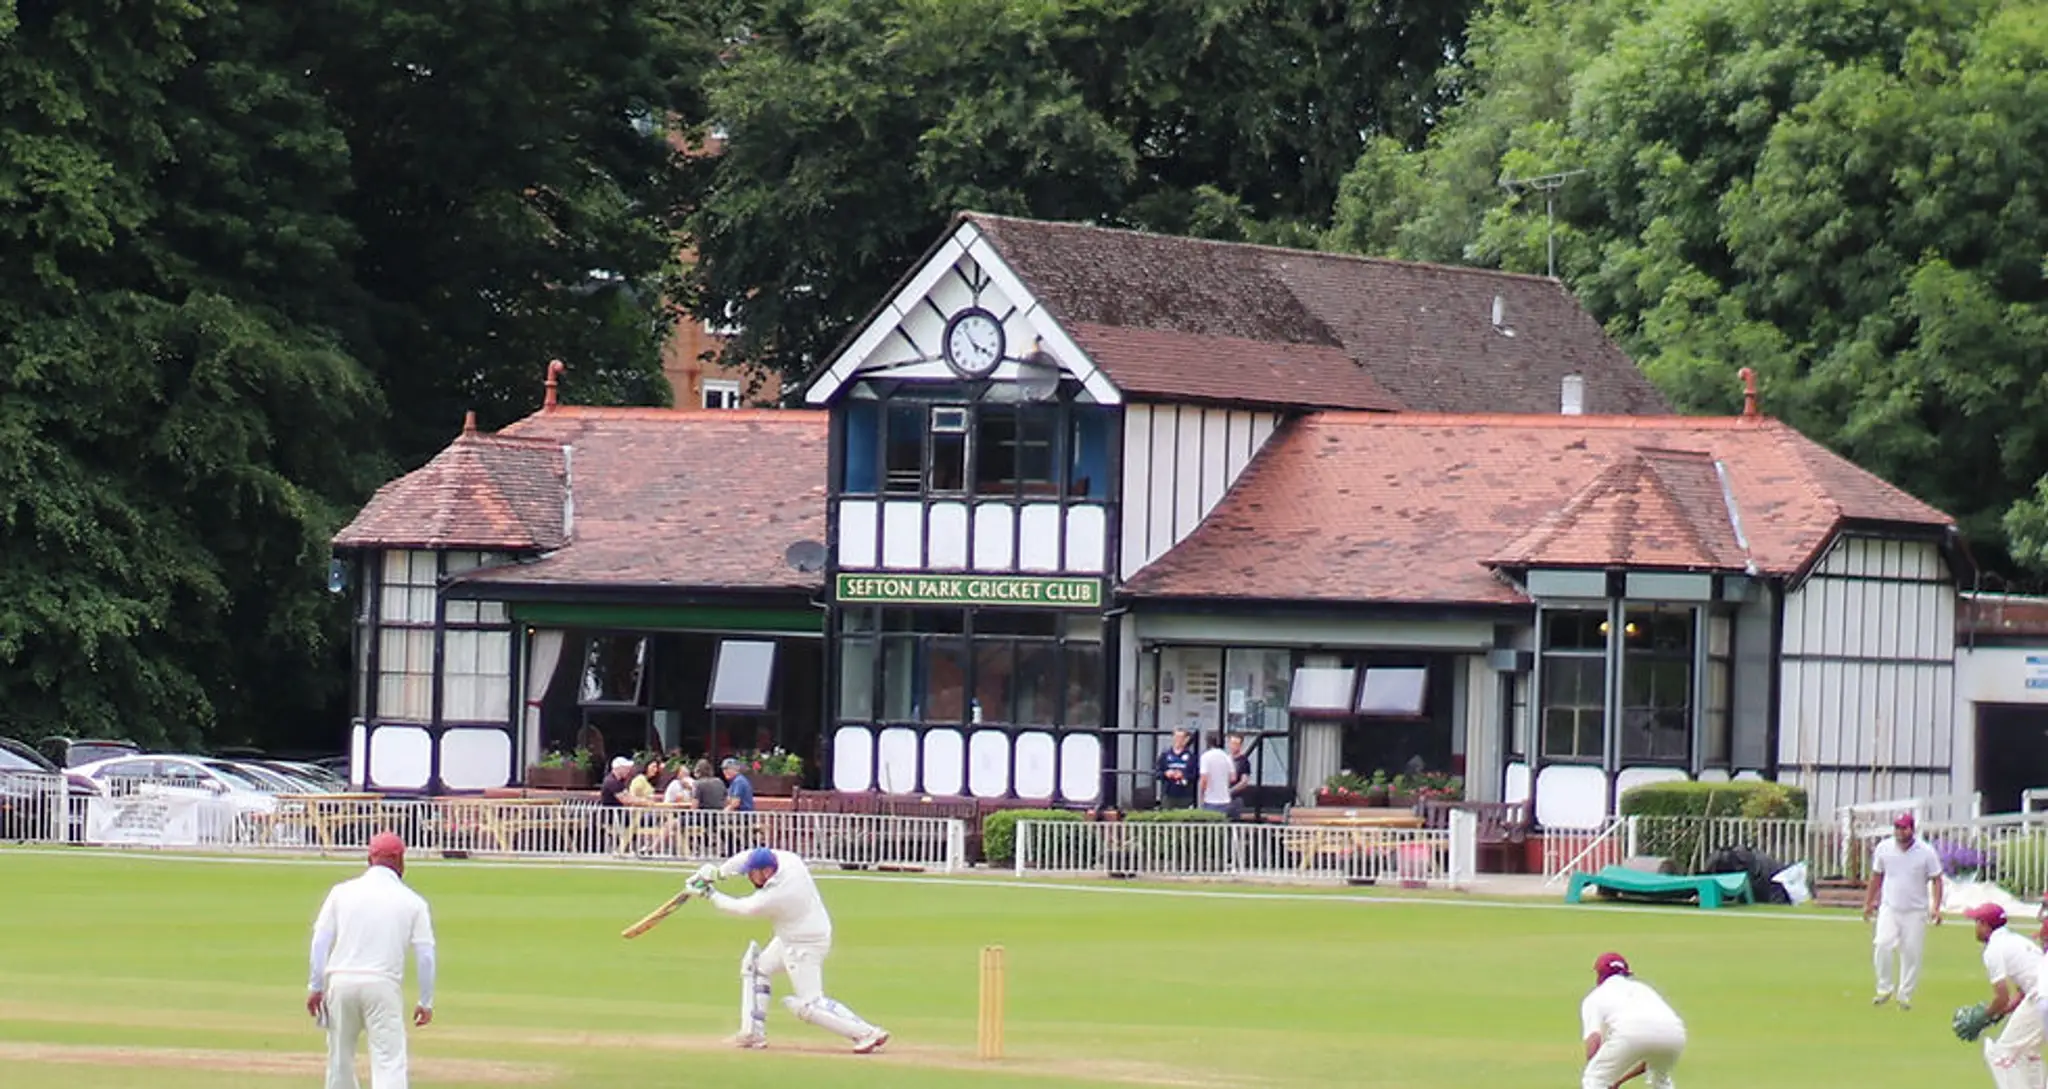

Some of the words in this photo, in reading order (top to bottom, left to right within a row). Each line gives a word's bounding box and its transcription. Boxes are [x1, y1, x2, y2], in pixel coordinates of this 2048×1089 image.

[847, 579, 912, 596] SEFTON
[919, 580, 962, 598] PARK
[967, 581, 1042, 599] CRICKET
[1045, 583, 1091, 600] CLUB
